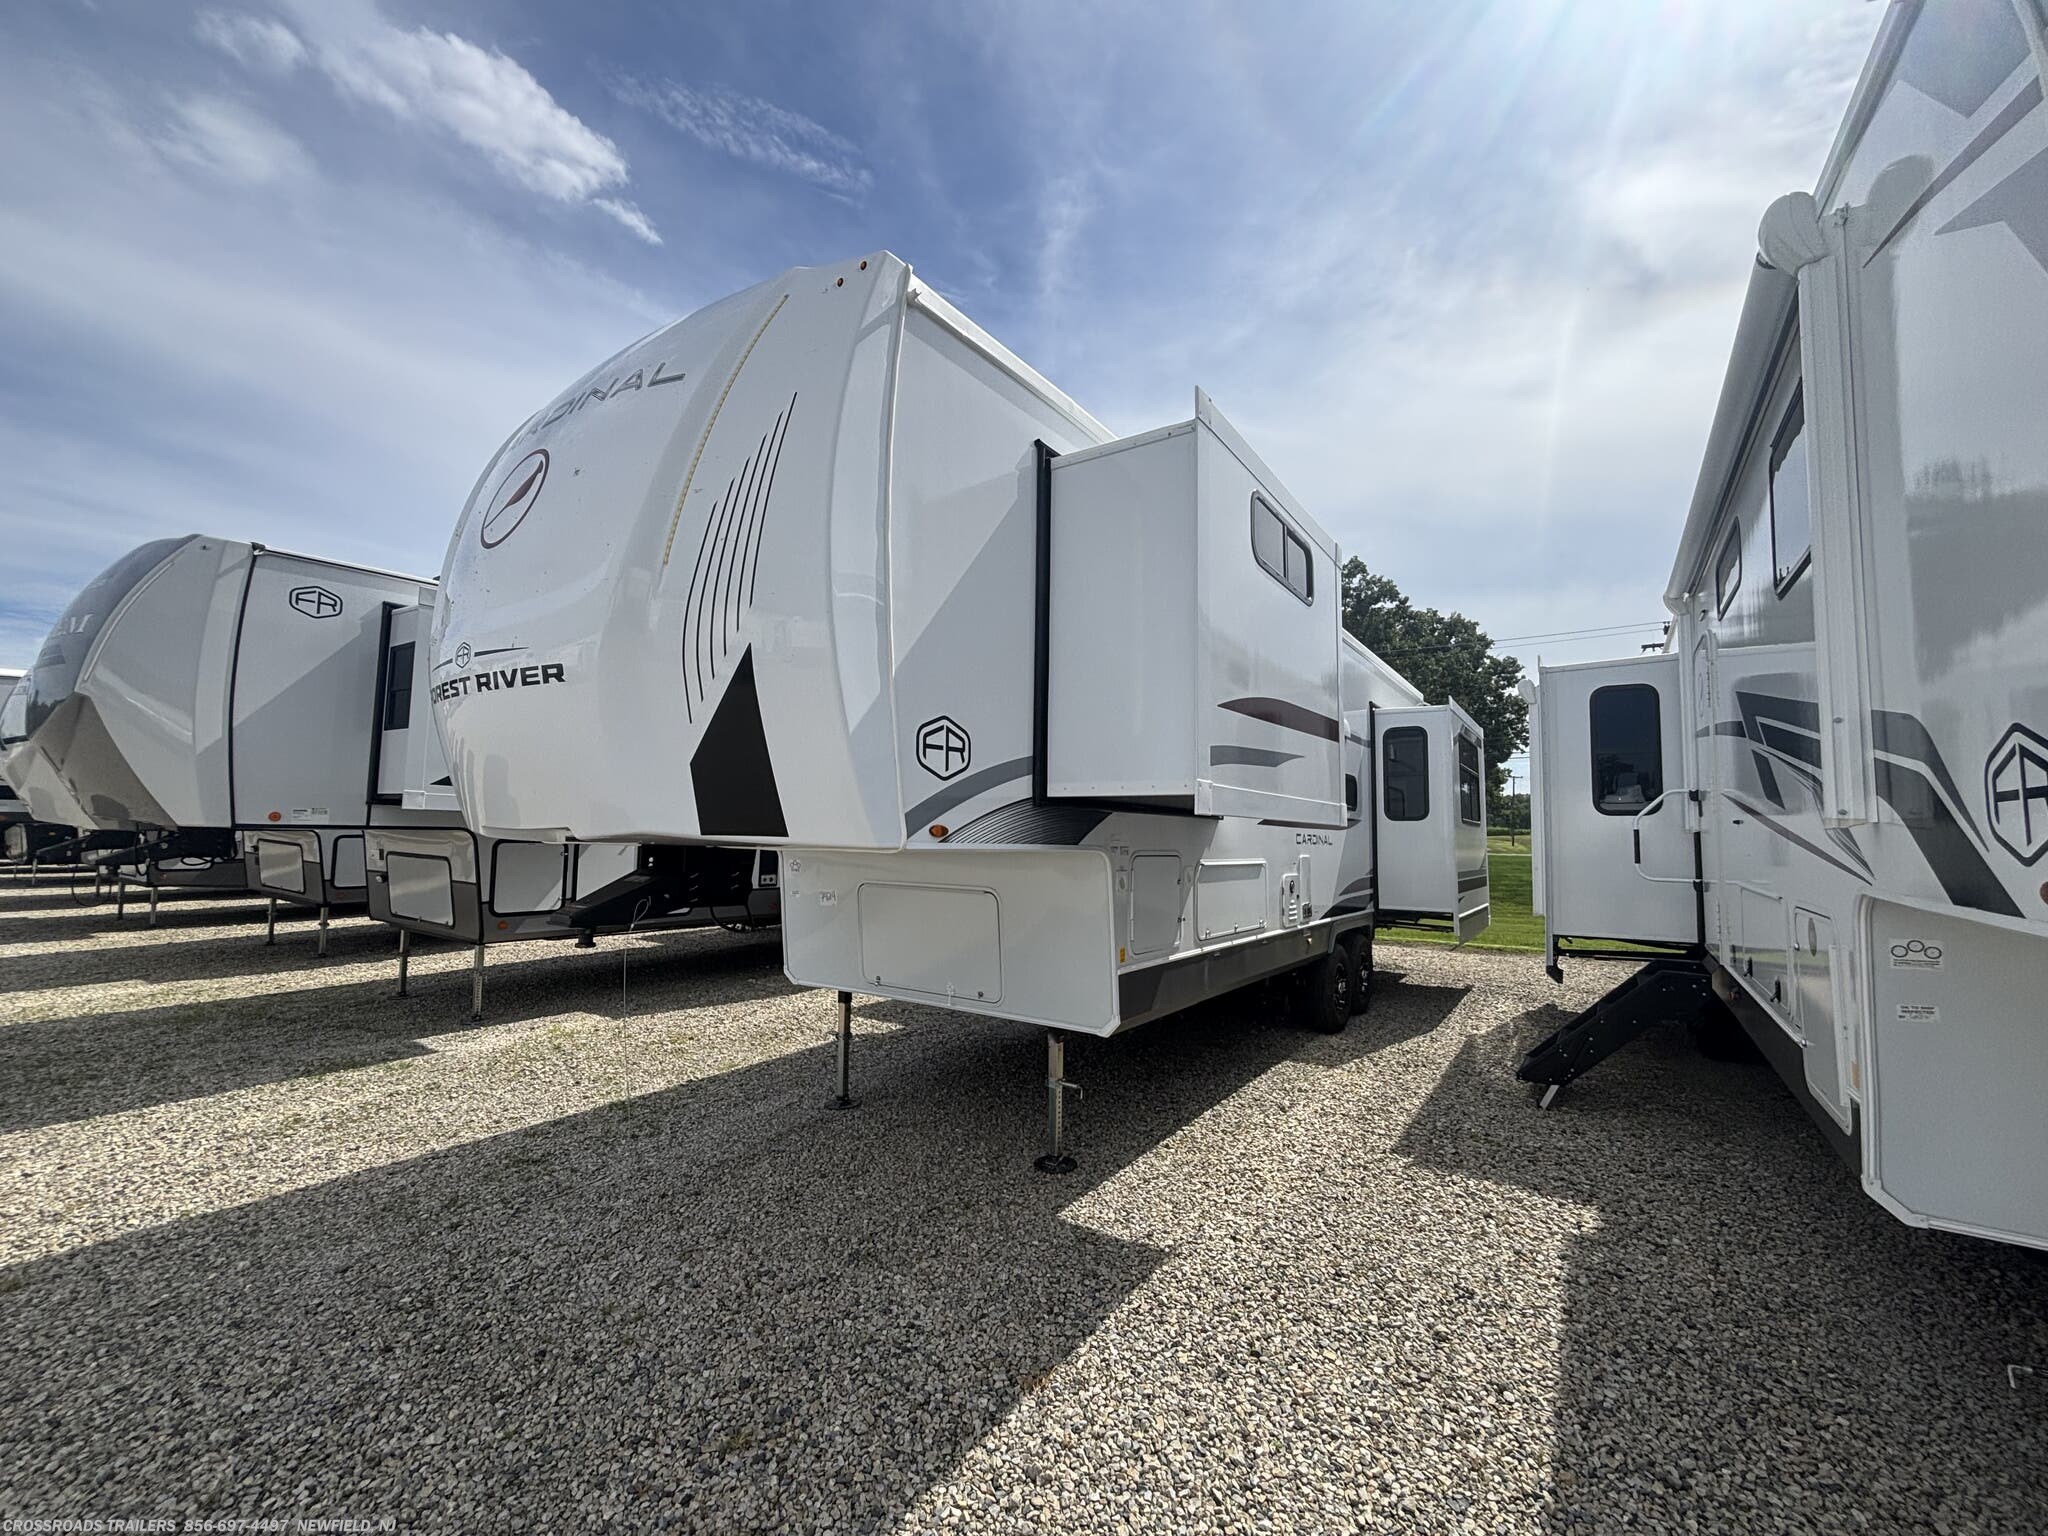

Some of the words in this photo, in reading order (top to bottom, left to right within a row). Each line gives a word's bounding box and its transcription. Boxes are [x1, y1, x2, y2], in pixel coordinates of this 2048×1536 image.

[431, 676, 471, 704] OREST
[475, 663, 566, 692] RIVER
[1296, 833, 1333, 846] CARDINAL
